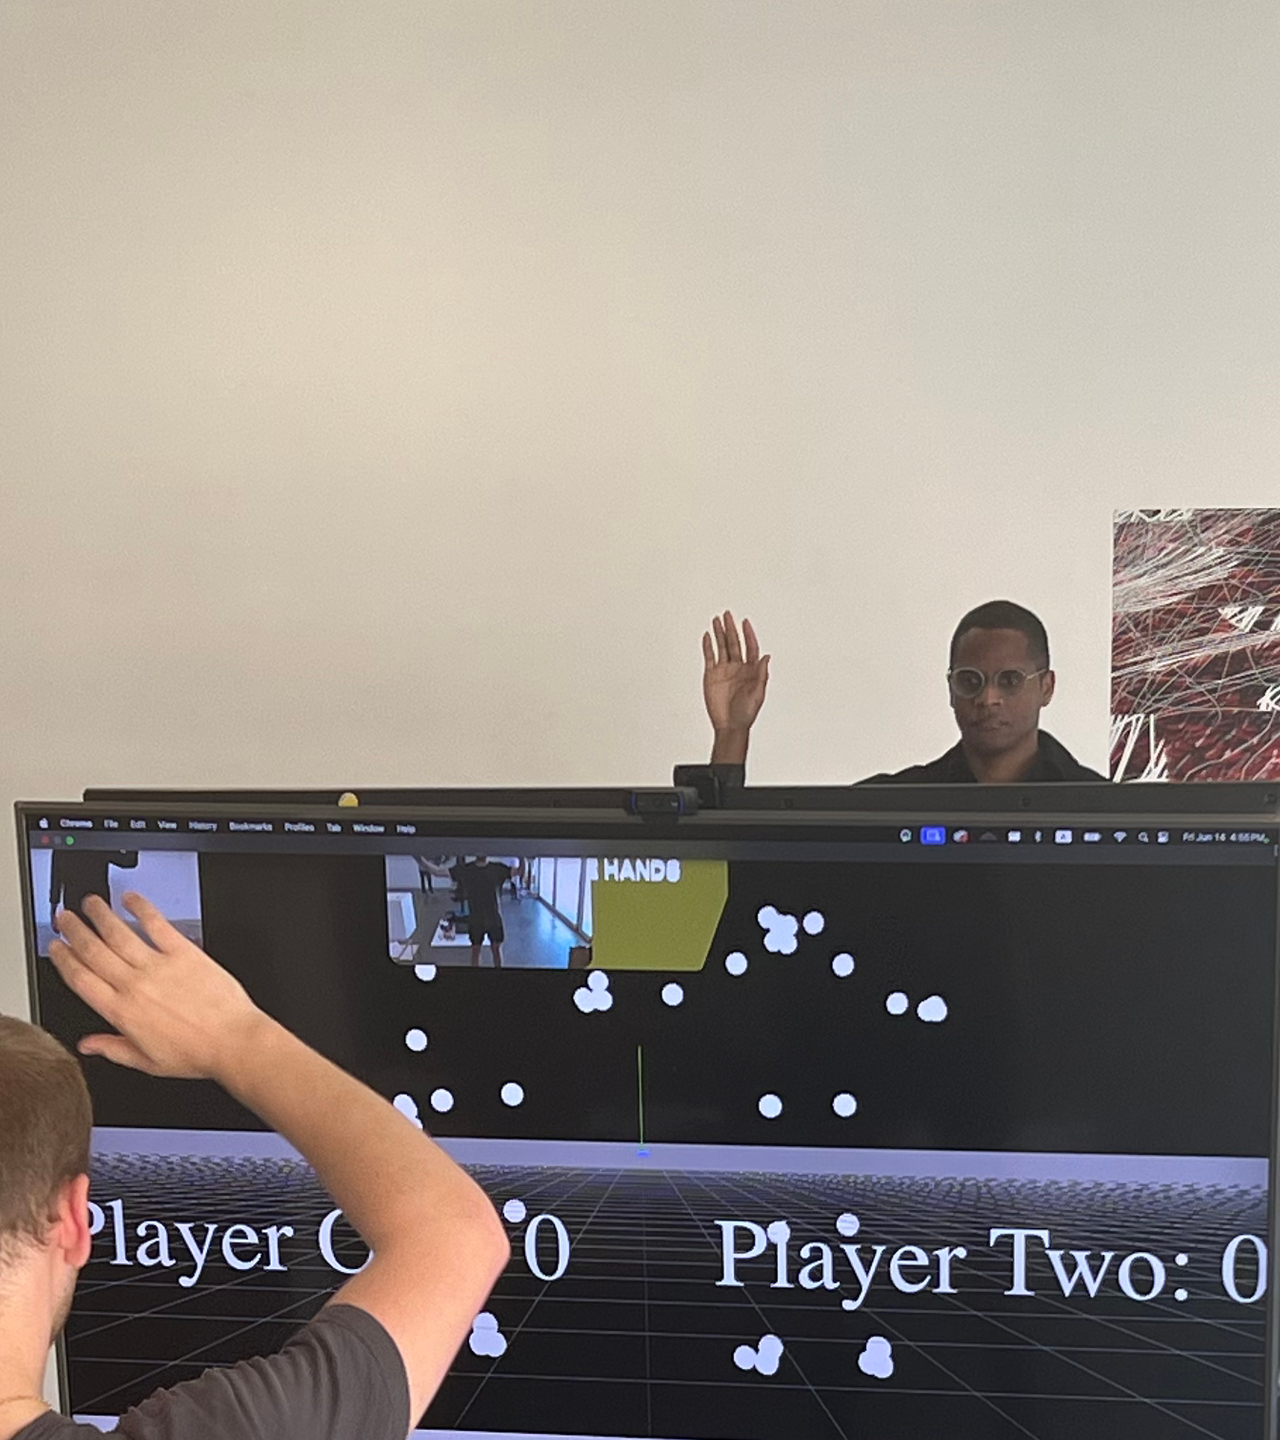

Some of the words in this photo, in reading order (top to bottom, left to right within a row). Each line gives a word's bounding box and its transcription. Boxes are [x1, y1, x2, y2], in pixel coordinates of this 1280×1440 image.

[103, 819, 119, 829] File
[130, 819, 146, 829] Edit
[188, 821, 218, 832] History
[229, 821, 273, 832] Bookmarks
[284, 822, 315, 833] Profiles
[326, 823, 342, 833] Tab
[352, 824, 385, 833] Window
[713, 1218, 967, 1312] Player
[988, 1227, 1189, 1302] Two:
[1221, 1233, 1268, 1304] 0
